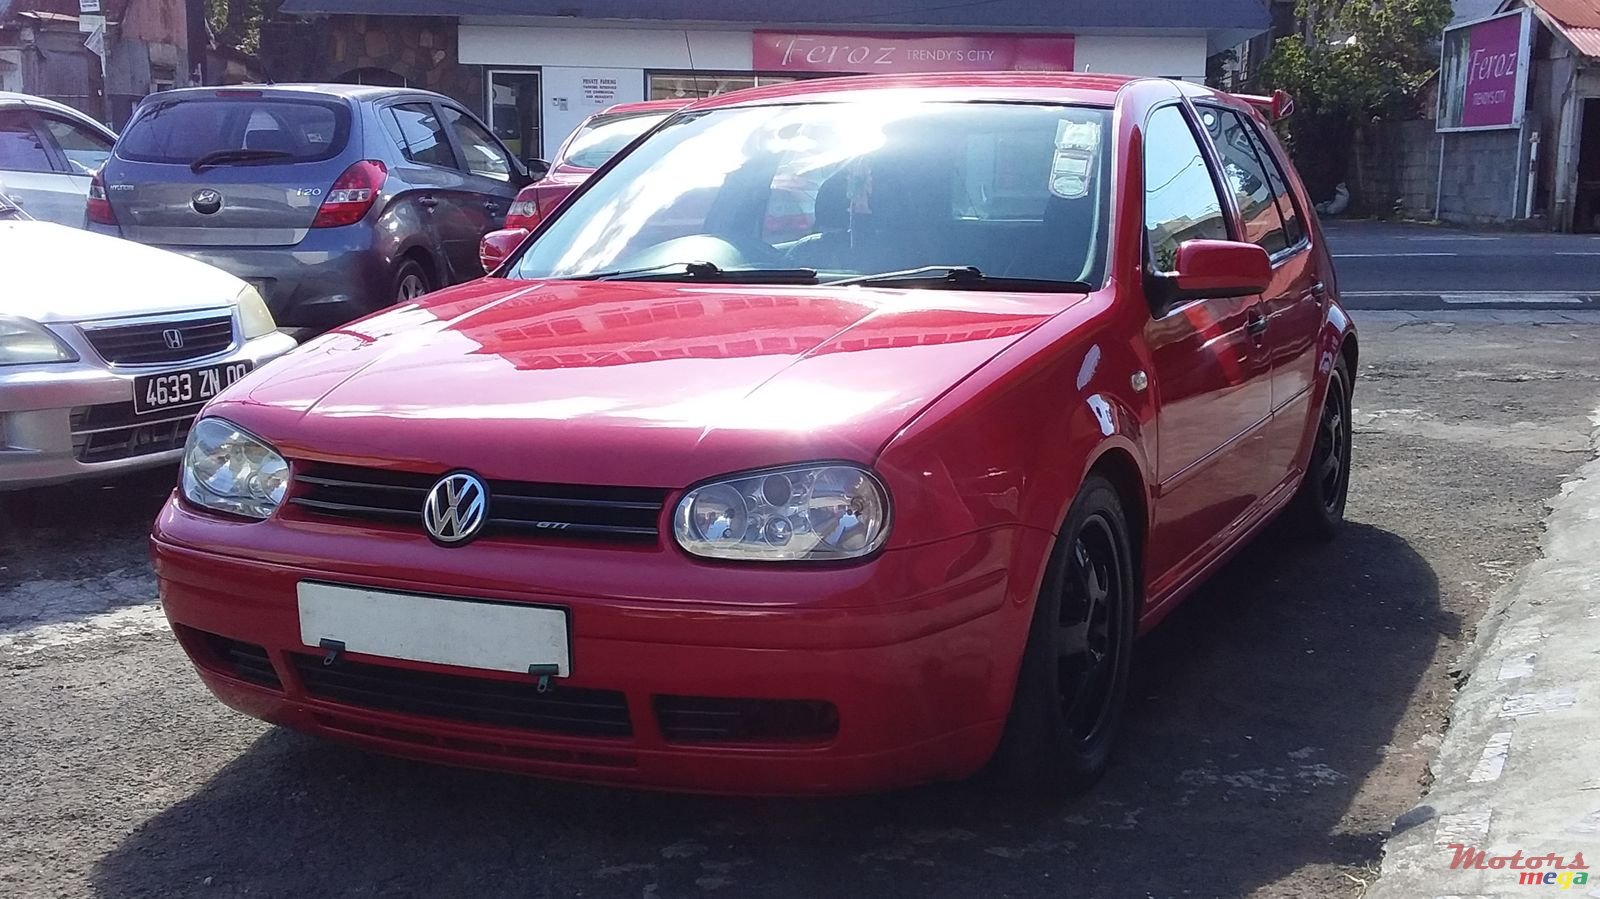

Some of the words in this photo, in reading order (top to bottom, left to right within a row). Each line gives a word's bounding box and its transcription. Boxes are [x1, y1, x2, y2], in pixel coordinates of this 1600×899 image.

[776, 38, 896, 66] Feroz
[905, 48, 964, 61] TRENDY'S
[966, 49, 994, 62] CITY
[1467, 48, 1517, 86] Feroz
[296, 187, 322, 196] i20
[146, 373, 192, 406] 4633
[198, 368, 221, 398] ZN
[536, 521, 571, 530] GTI
